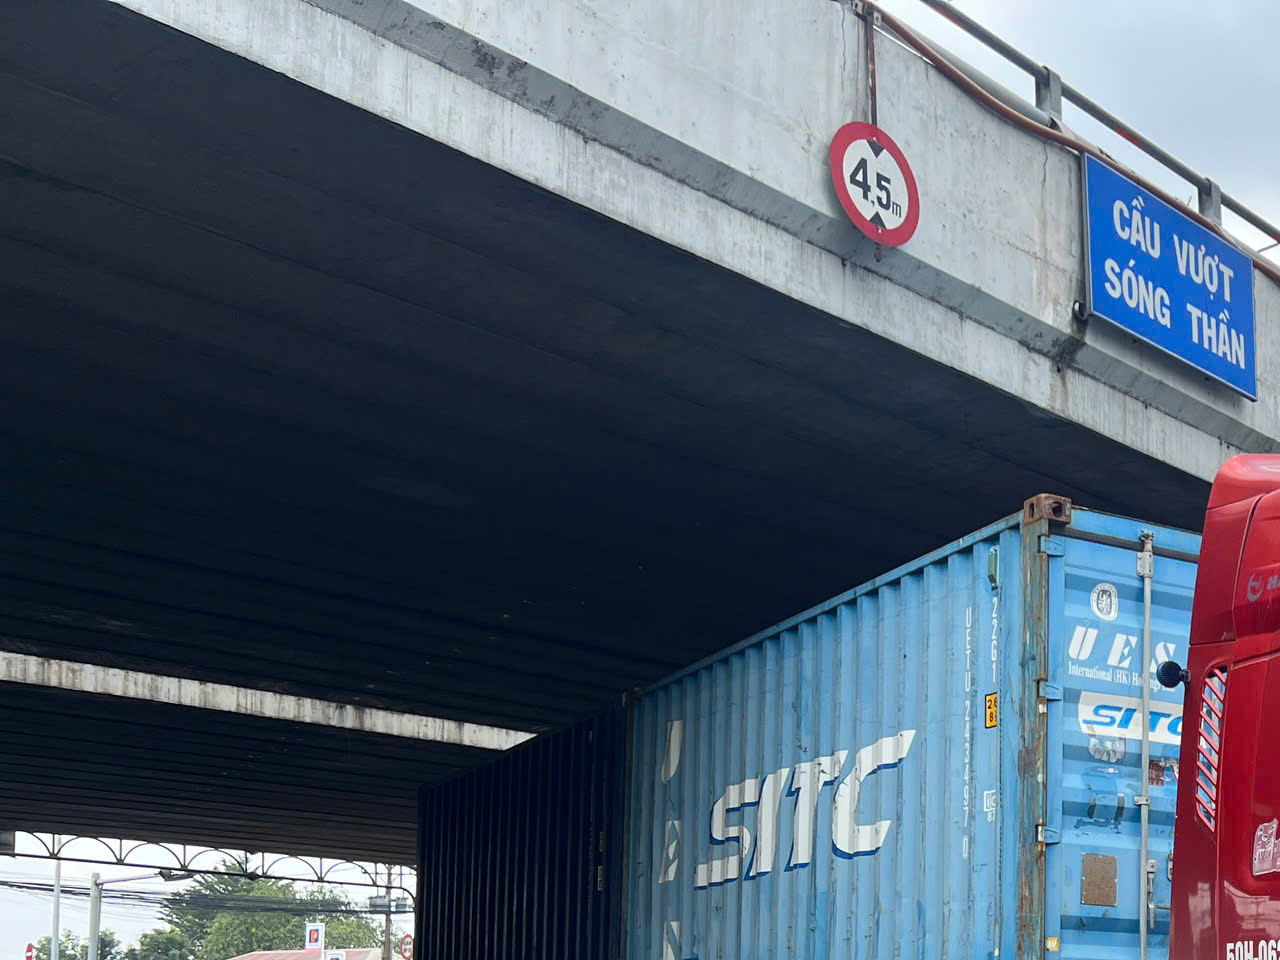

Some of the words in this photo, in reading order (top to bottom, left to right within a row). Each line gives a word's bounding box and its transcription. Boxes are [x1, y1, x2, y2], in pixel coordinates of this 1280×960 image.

[1112, 195, 1161, 260] CẦU
[1172, 233, 1235, 303] VƯỢT
[1104, 258, 1171, 330] SÓNG
[1186, 302, 1247, 369] THẦN
[964, 607, 972, 692] UETU
[1068, 660, 1113, 683] International
[1113, 670, 1132, 686] (HK)
[694, 730, 917, 891] SITC
